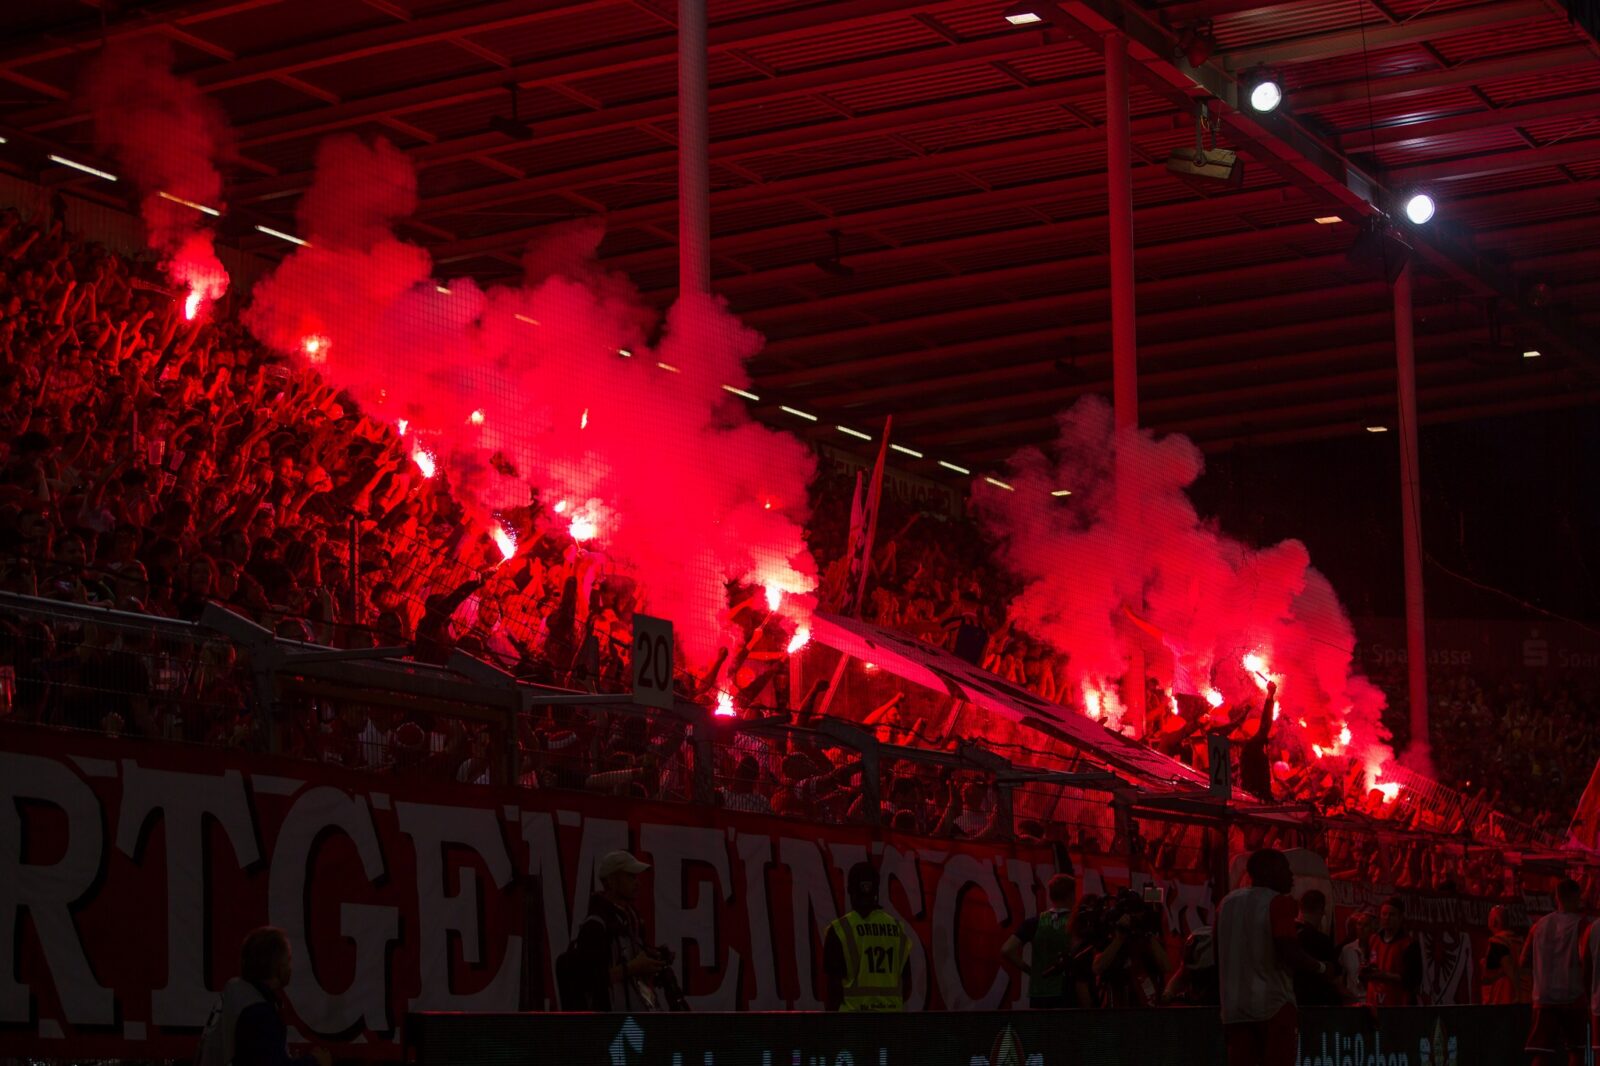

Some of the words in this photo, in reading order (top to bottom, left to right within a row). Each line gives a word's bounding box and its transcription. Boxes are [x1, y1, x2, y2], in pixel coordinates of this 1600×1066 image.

[638, 632, 669, 691] 20
[1371, 643, 1472, 668] Spaasse
[1213, 746, 1228, 786] 21
[856, 923, 899, 937] ORDNER
[864, 946, 894, 973] 121
